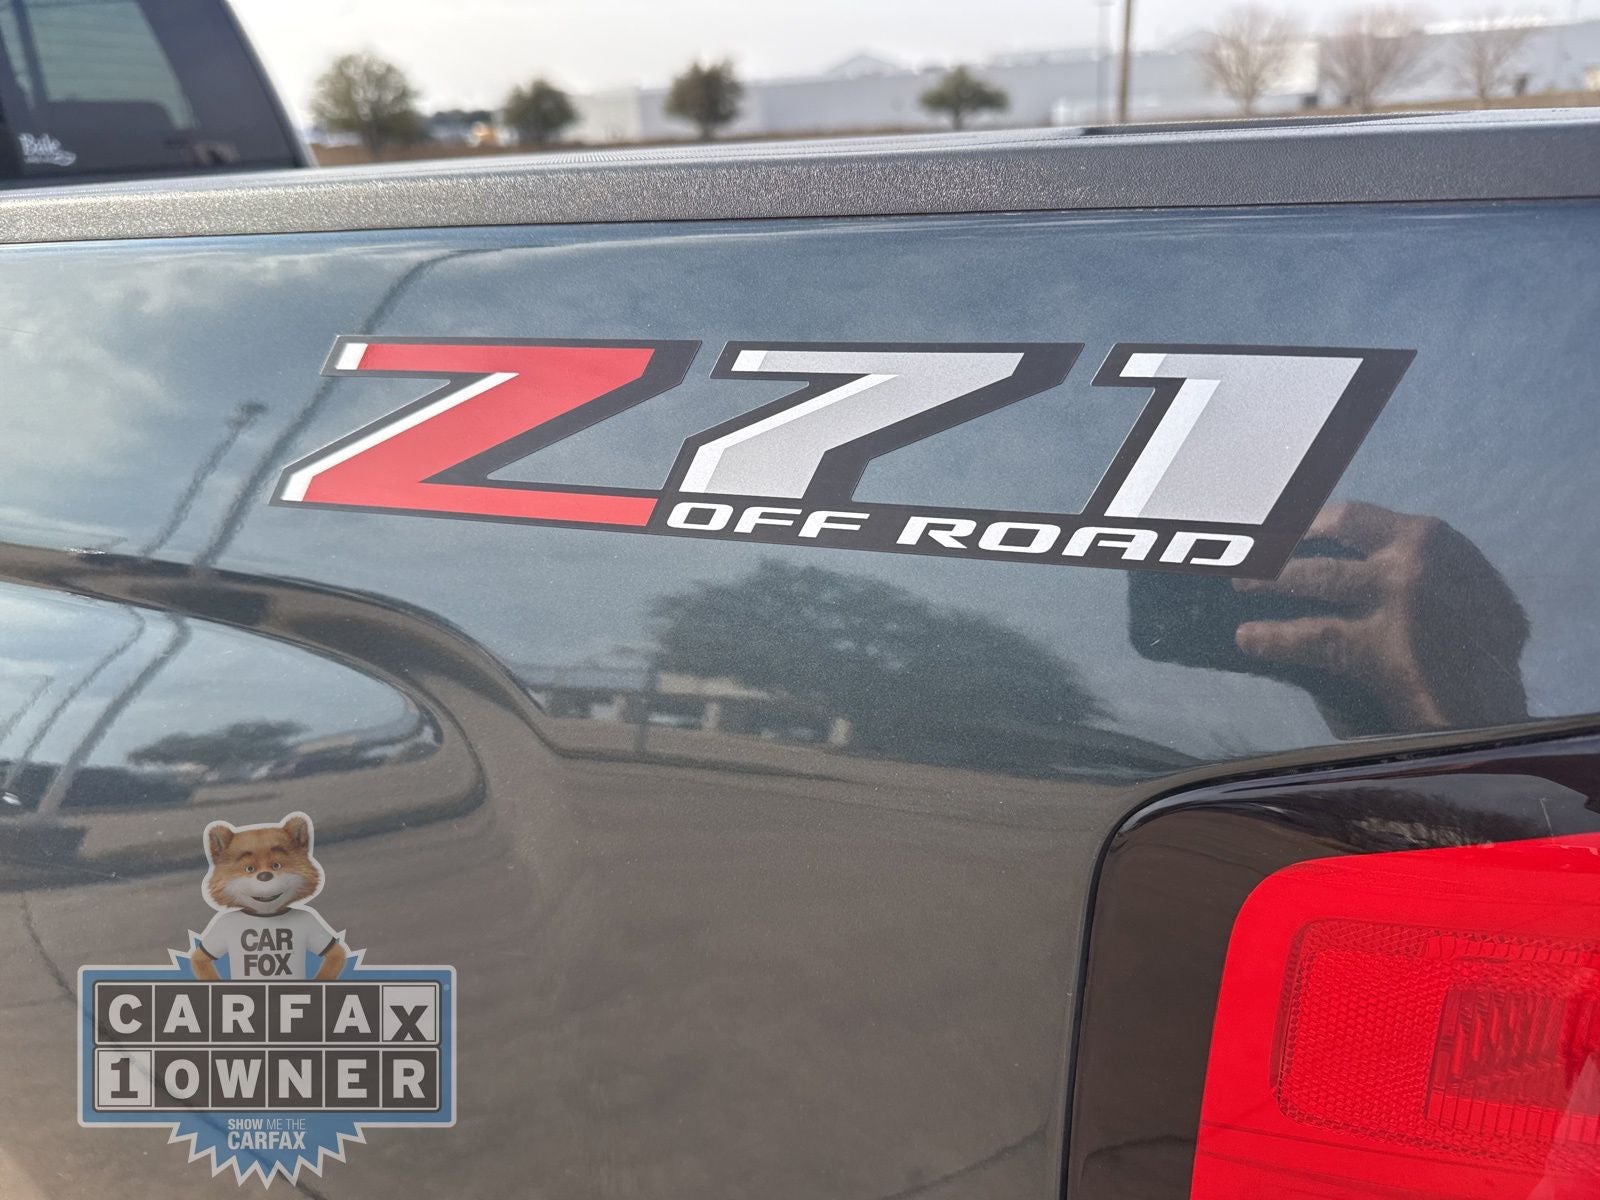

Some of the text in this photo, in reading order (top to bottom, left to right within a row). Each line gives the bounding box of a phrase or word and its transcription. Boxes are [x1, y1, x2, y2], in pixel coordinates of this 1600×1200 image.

[278, 340, 1366, 527] Z71
[666, 501, 1255, 568] OFF ROAD
